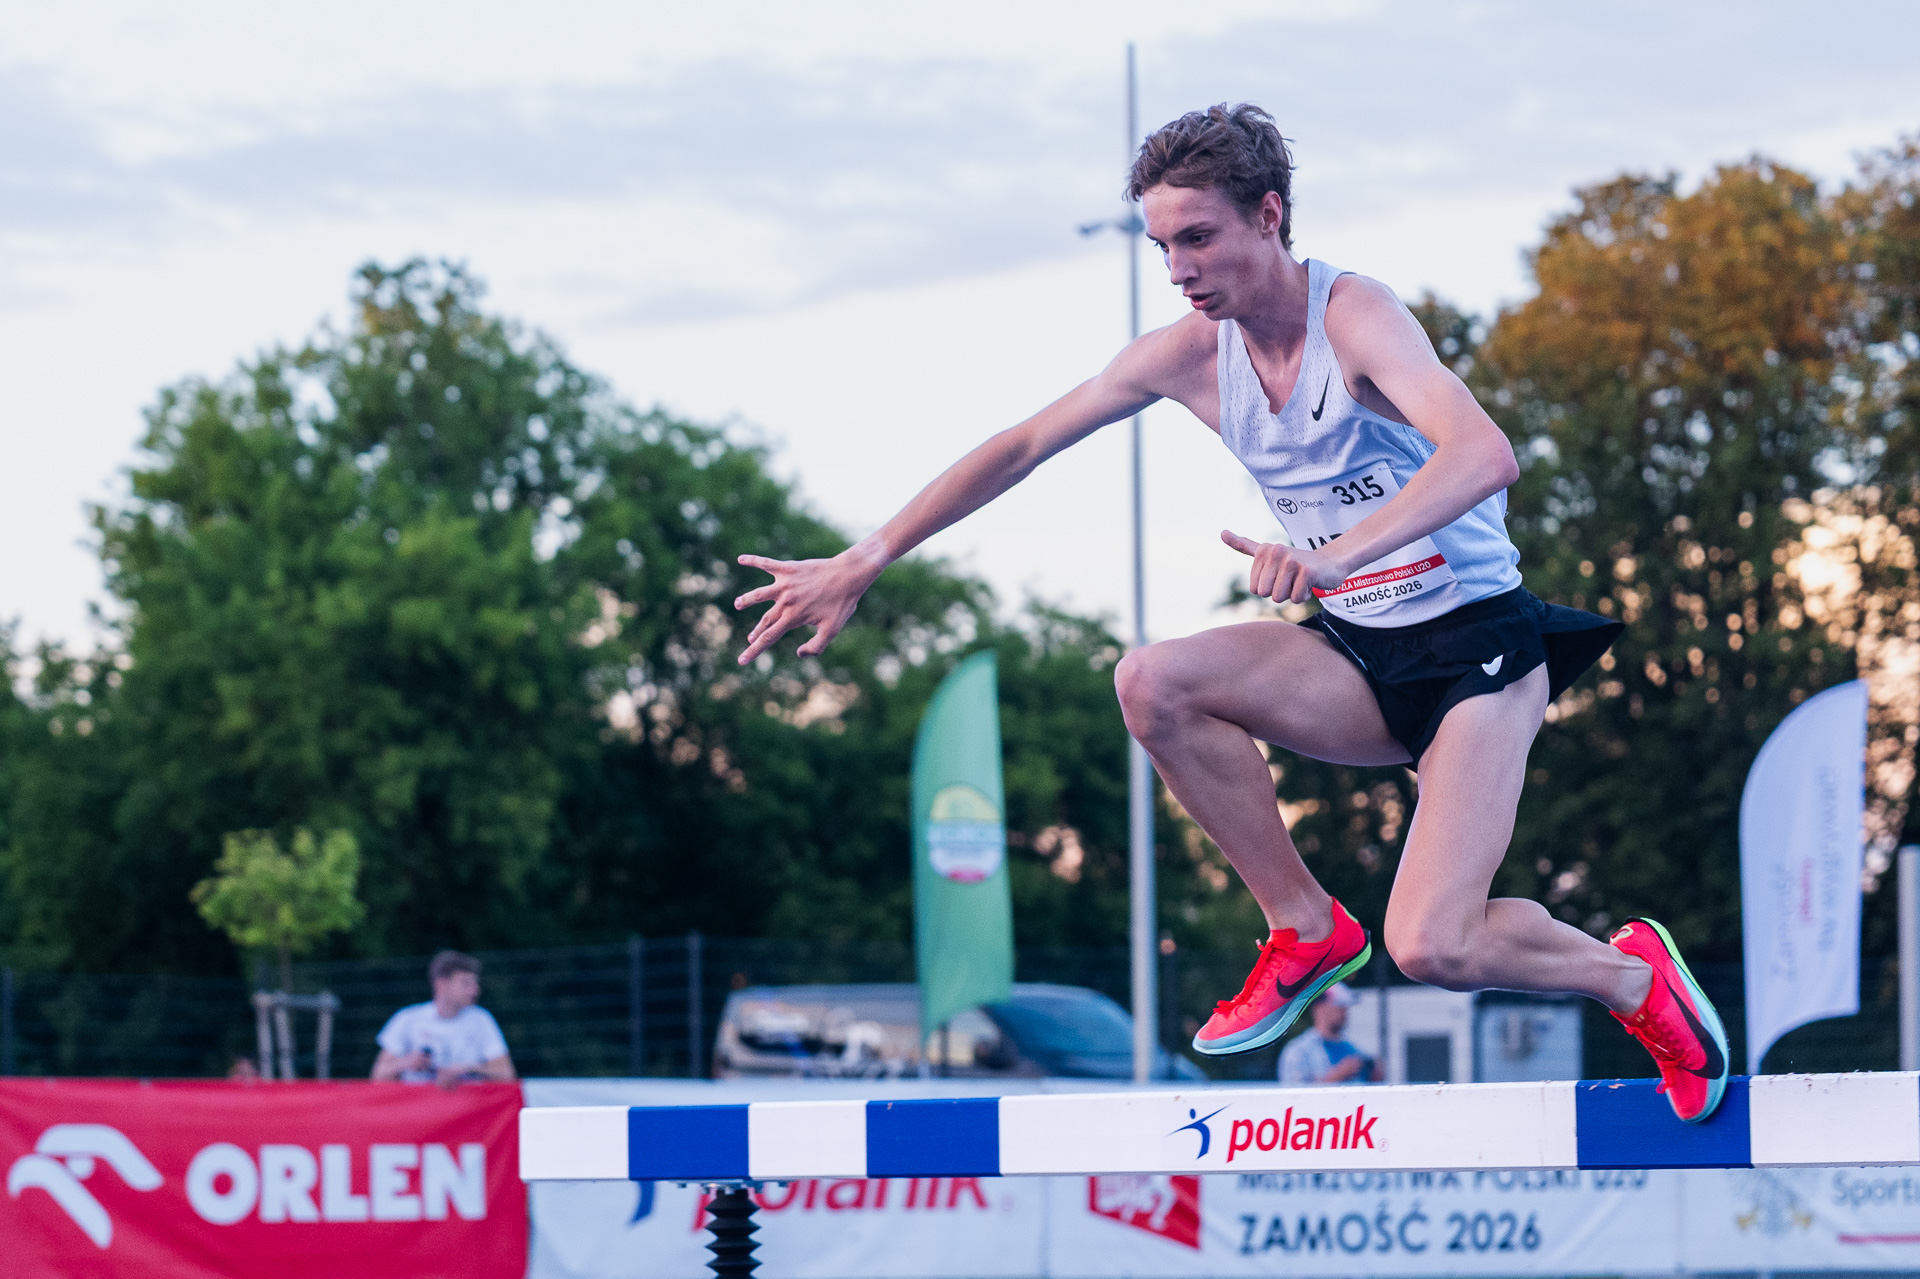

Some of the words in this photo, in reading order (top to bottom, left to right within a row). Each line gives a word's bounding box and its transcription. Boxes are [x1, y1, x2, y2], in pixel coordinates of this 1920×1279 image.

[1332, 475, 1385, 505] 315
[1353, 573, 1395, 588] Mistrzostwa
[1394, 566, 1415, 578] Polski
[1414, 561, 1431, 572] U20
[1343, 585, 1392, 608] ZAMOŚĆ
[1394, 580, 1423, 597] 2026
[186, 1142, 487, 1226] ORLEN
[1239, 1197, 1429, 1255] ZAMOŚĆ
[1446, 1211, 1541, 1253] 2026
